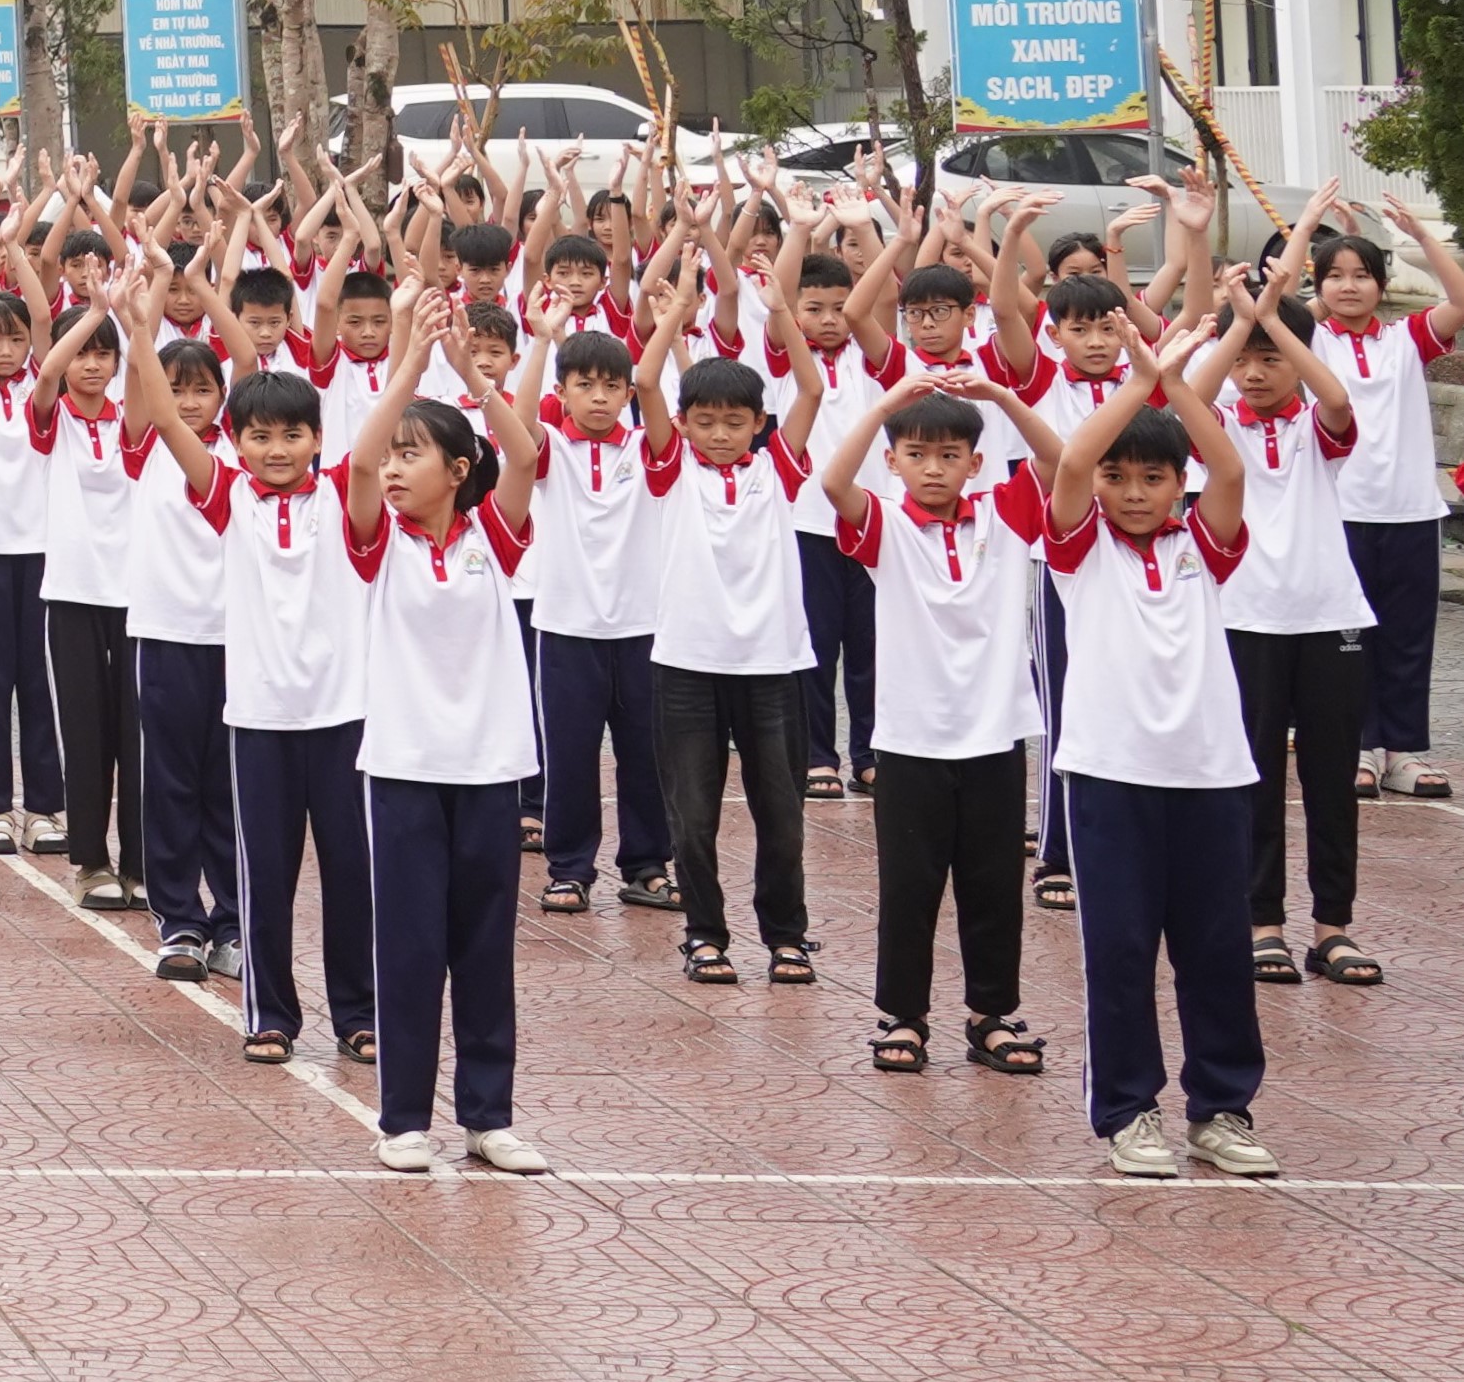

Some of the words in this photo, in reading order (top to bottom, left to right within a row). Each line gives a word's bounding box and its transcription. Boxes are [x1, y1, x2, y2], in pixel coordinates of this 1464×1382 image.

[152, 17, 170, 31] EM
[171, 15, 186, 32] TỰ
[187, 13, 210, 29] HÀO
[139, 33, 153, 51] VỀ
[155, 34, 177, 50] NHÀ
[1011, 38, 1086, 64] XANH,
[157, 54, 186, 69] NGÀY
[187, 54, 209, 68] MAI
[150, 73, 174, 89] NHÀ
[175, 71, 217, 88] TRƯỜNG
[986, 76, 1060, 105] SẠCH,
[1065, 74, 1114, 104] ĐẸP
[148, 93, 163, 111] TỰ
[164, 92, 186, 108] HÀO
[188, 90, 203, 107] VỀ
[204, 92, 222, 107] EM
